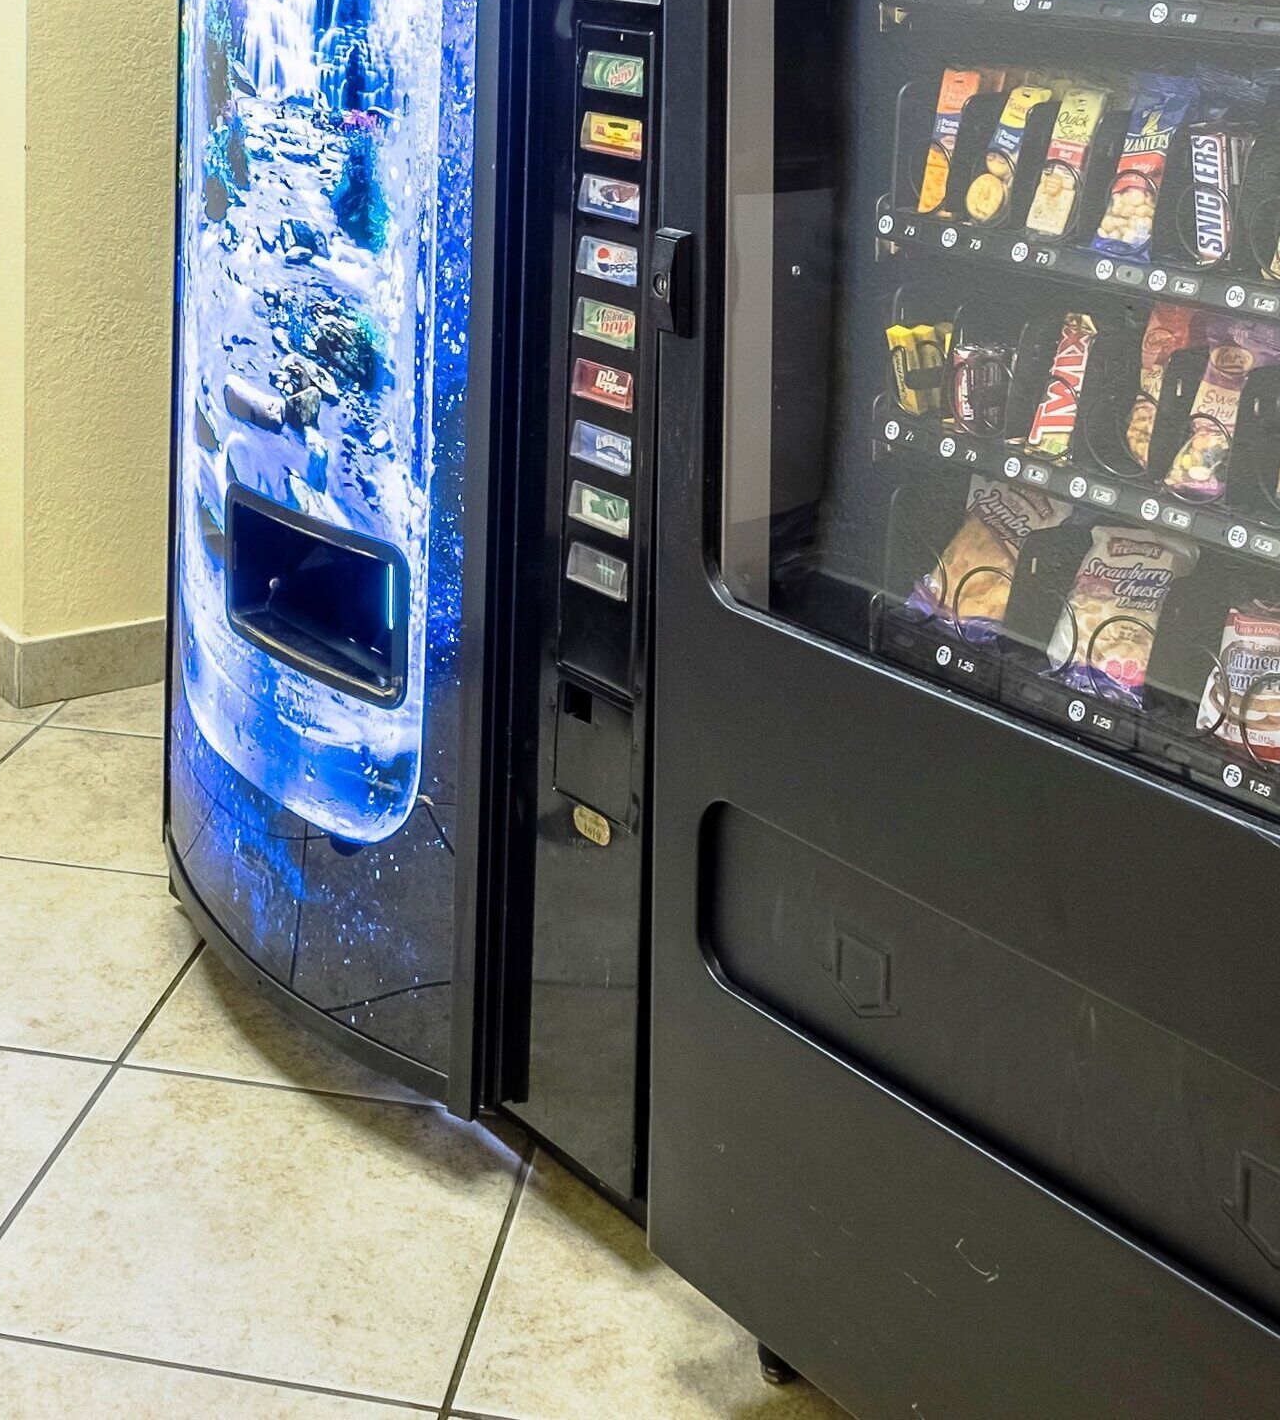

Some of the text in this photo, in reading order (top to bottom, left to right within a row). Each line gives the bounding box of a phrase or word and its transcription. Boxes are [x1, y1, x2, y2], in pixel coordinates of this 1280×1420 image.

[1058, 111, 1091, 128] Quick
[1191, 135, 1225, 260] SNICERS
[880, 218, 892, 230] D1
[943, 232, 982, 250] D2 75
[1014, 245, 1049, 264] D3 75
[610, 263, 635, 274] PEPSI
[1098, 263, 1111, 275] D4
[1151, 274, 1166, 286] D5
[1228, 290, 1243, 302] D6
[595, 370, 629, 396] Pepper
[607, 369, 620, 384] Dr
[1028, 327, 1094, 446] TWIX
[942, 441, 955, 453] E2
[966, 488, 1031, 537] Jumbo
[1143, 504, 1157, 516] E5
[1229, 530, 1245, 543] E6
[1084, 558, 1173, 587] Strawberry
[1113, 580, 1165, 598] Cheese
[1117, 596, 1157, 613] Danish
[937, 650, 975, 674] F1 1.25
[1070, 704, 1112, 730] F3 1.25
[1225, 768, 1272, 798] F5 1.25
